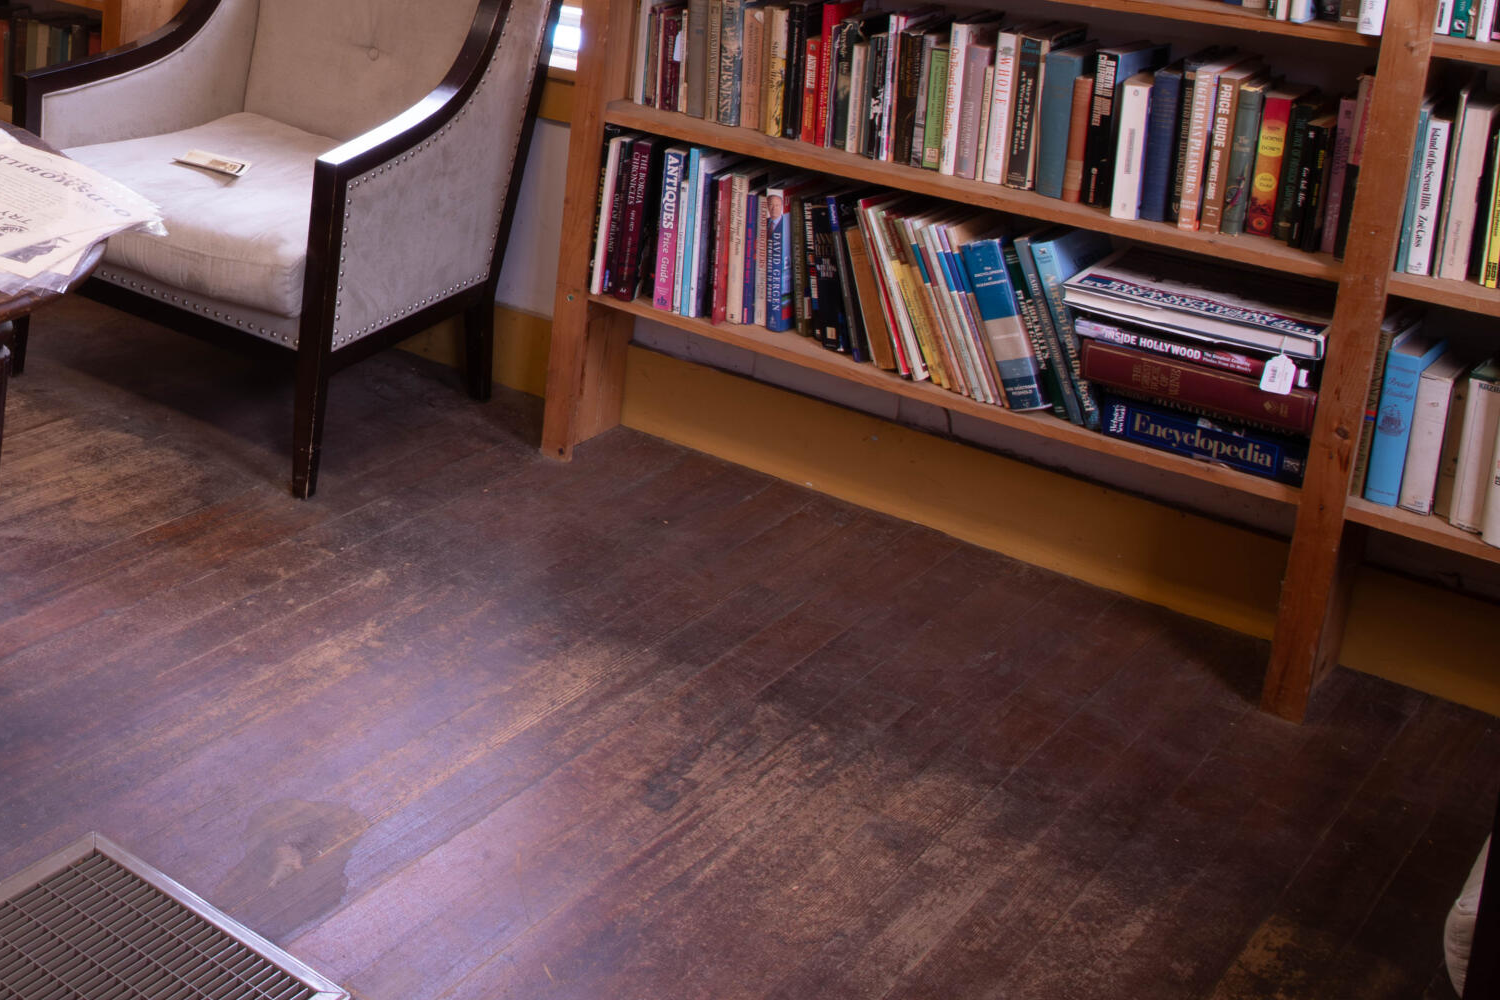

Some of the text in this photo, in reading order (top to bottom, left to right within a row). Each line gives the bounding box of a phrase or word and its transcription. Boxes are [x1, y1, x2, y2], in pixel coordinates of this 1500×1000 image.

[806, 53, 816, 89] ANN RULE
[941, 47, 961, 139] On Board with Bradley
[994, 56, 1013, 106] WHOLE
[1012, 83, 1026, 156] Wounded Knee
[1019, 78, 1034, 151] Bury My Heart
[1185, 73, 1211, 195] VEGETARIAN PLEASURES
[1212, 83, 1233, 149] PRICE GUIDE
[627, 151, 641, 205] CHRONICLES
[635, 153, 650, 205] THE BORGIA
[1414, 127, 1441, 248] Island of the Seven Hills Cass
[607, 220, 617, 253] IRELAND
[659, 153, 681, 284] ANTIQUES Price Guide
[758, 200, 768, 269] BLOOD BROTHERS
[804, 202, 818, 250] SEAN HANNITY
[771, 231, 782, 312] DAVID GERGEN
[1058, 327, 1079, 360] From
[1075, 380, 1094, 411] Road
[1104, 325, 1202, 361] INSIDE HOLLYWOOD
[1133, 411, 1272, 468] Encyclopedia
